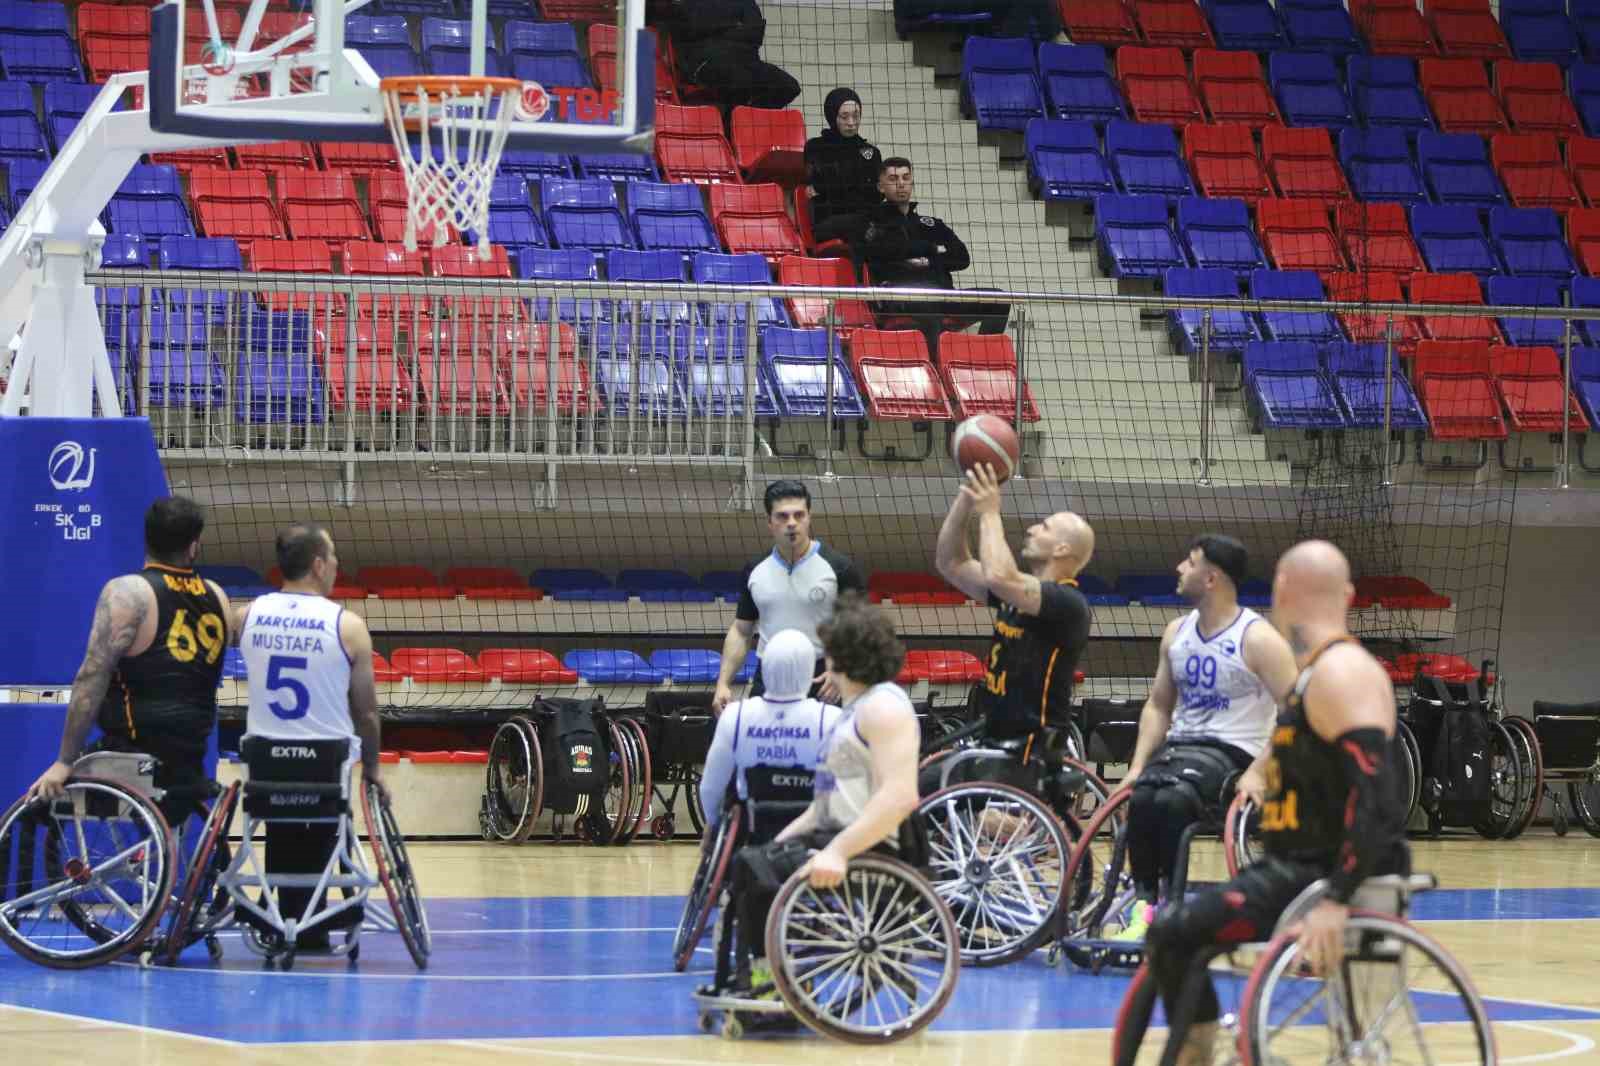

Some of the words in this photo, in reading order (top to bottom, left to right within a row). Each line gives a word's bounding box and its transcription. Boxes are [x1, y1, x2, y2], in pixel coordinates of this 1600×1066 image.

[552, 87, 619, 121] TBF
[55, 514, 74, 526] SK
[167, 609, 225, 664] 69
[252, 633, 324, 653] MUSTAFA
[266, 655, 310, 720] 5
[1186, 655, 1216, 688] 99
[271, 746, 317, 758] EXTRA
